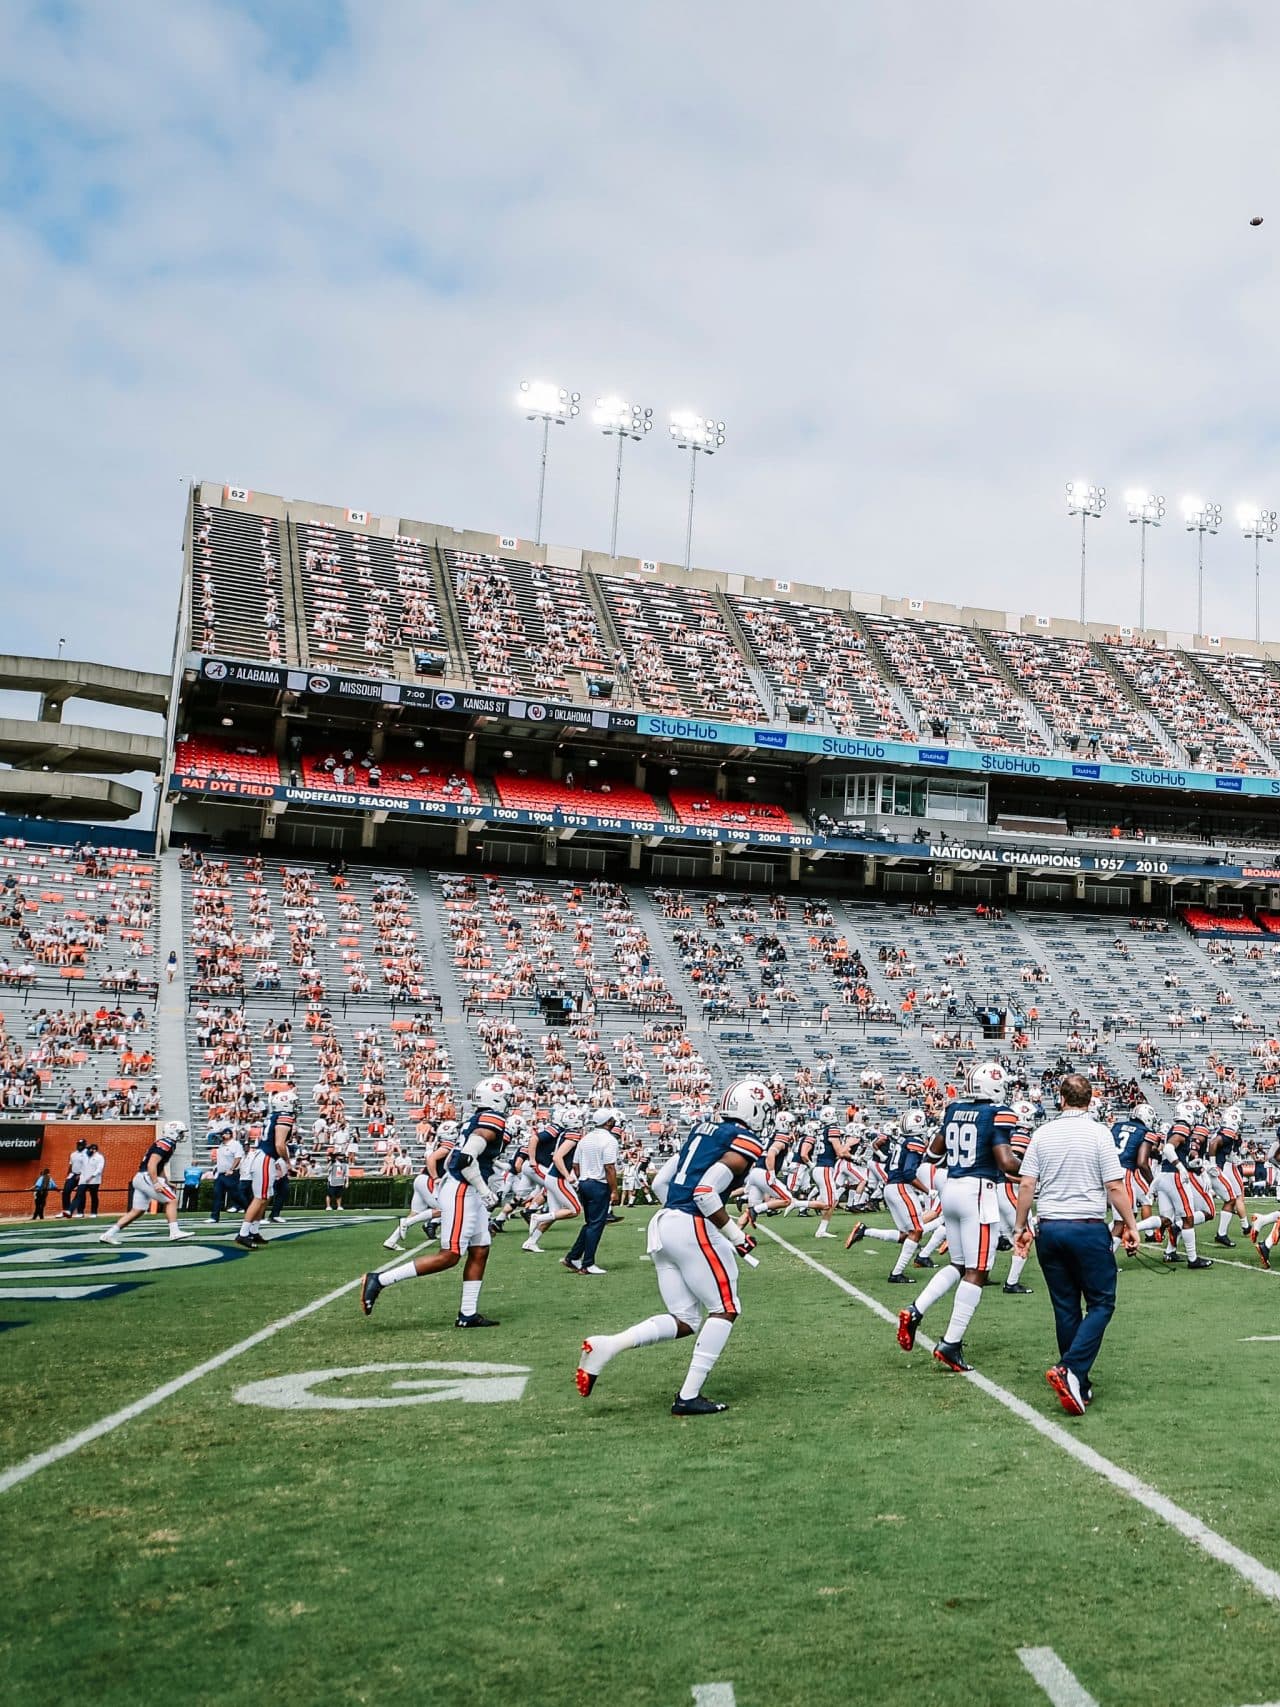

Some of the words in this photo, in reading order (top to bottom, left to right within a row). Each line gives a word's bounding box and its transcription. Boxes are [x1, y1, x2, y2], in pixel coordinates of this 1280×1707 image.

[231, 490, 246, 499] 62
[352, 512, 364, 521] 61
[502, 539, 514, 547] 60
[643, 562, 655, 570] 59
[229, 668, 235, 676] 2
[236, 667, 280, 684] ALABAMA
[339, 682, 380, 698] MISSOURI
[406, 690, 425, 700] 7:00
[463, 697, 494, 712] KANSAS
[496, 702, 506, 713] ST
[554, 709, 591, 724] OKLAHOMA
[611, 718, 636, 727] 12:00
[650, 718, 718, 740] StubHub
[758, 733, 785, 744] StubHub
[822, 738, 886, 758] StubHub
[922, 751, 946, 761] StubHub
[981, 755, 1041, 774] StubHub
[1130, 769, 1186, 786] StubHub
[182, 778, 208, 790] PAT
[210, 780, 236, 793] DYE
[240, 784, 274, 796] FIELD
[286, 789, 356, 804] UNDEFEATED
[358, 796, 409, 810] SEASONS
[420, 802, 446, 813] 1893
[456, 806, 483, 816] 1897
[492, 809, 518, 820] 1900
[528, 812, 554, 823] 1904
[562, 816, 588, 826] 1913
[596, 818, 622, 829] 1914
[630, 820, 655, 832] 1932
[663, 824, 688, 835] 1957
[695, 827, 719, 838] 1958
[727, 830, 750, 841] 1993
[758, 834, 782, 843] 2004
[789, 836, 812, 846] 2010
[930, 845, 998, 862] NATIONAL
[1002, 851, 1081, 868] CHAMPIONS
[1094, 858, 1124, 870] 1957
[1136, 861, 1168, 874] 2010
[0, 1138, 36, 1148] verizon
[945, 1122, 978, 1168] 99
[674, 1134, 702, 1186] 1
[232, 1361, 532, 1410] G
